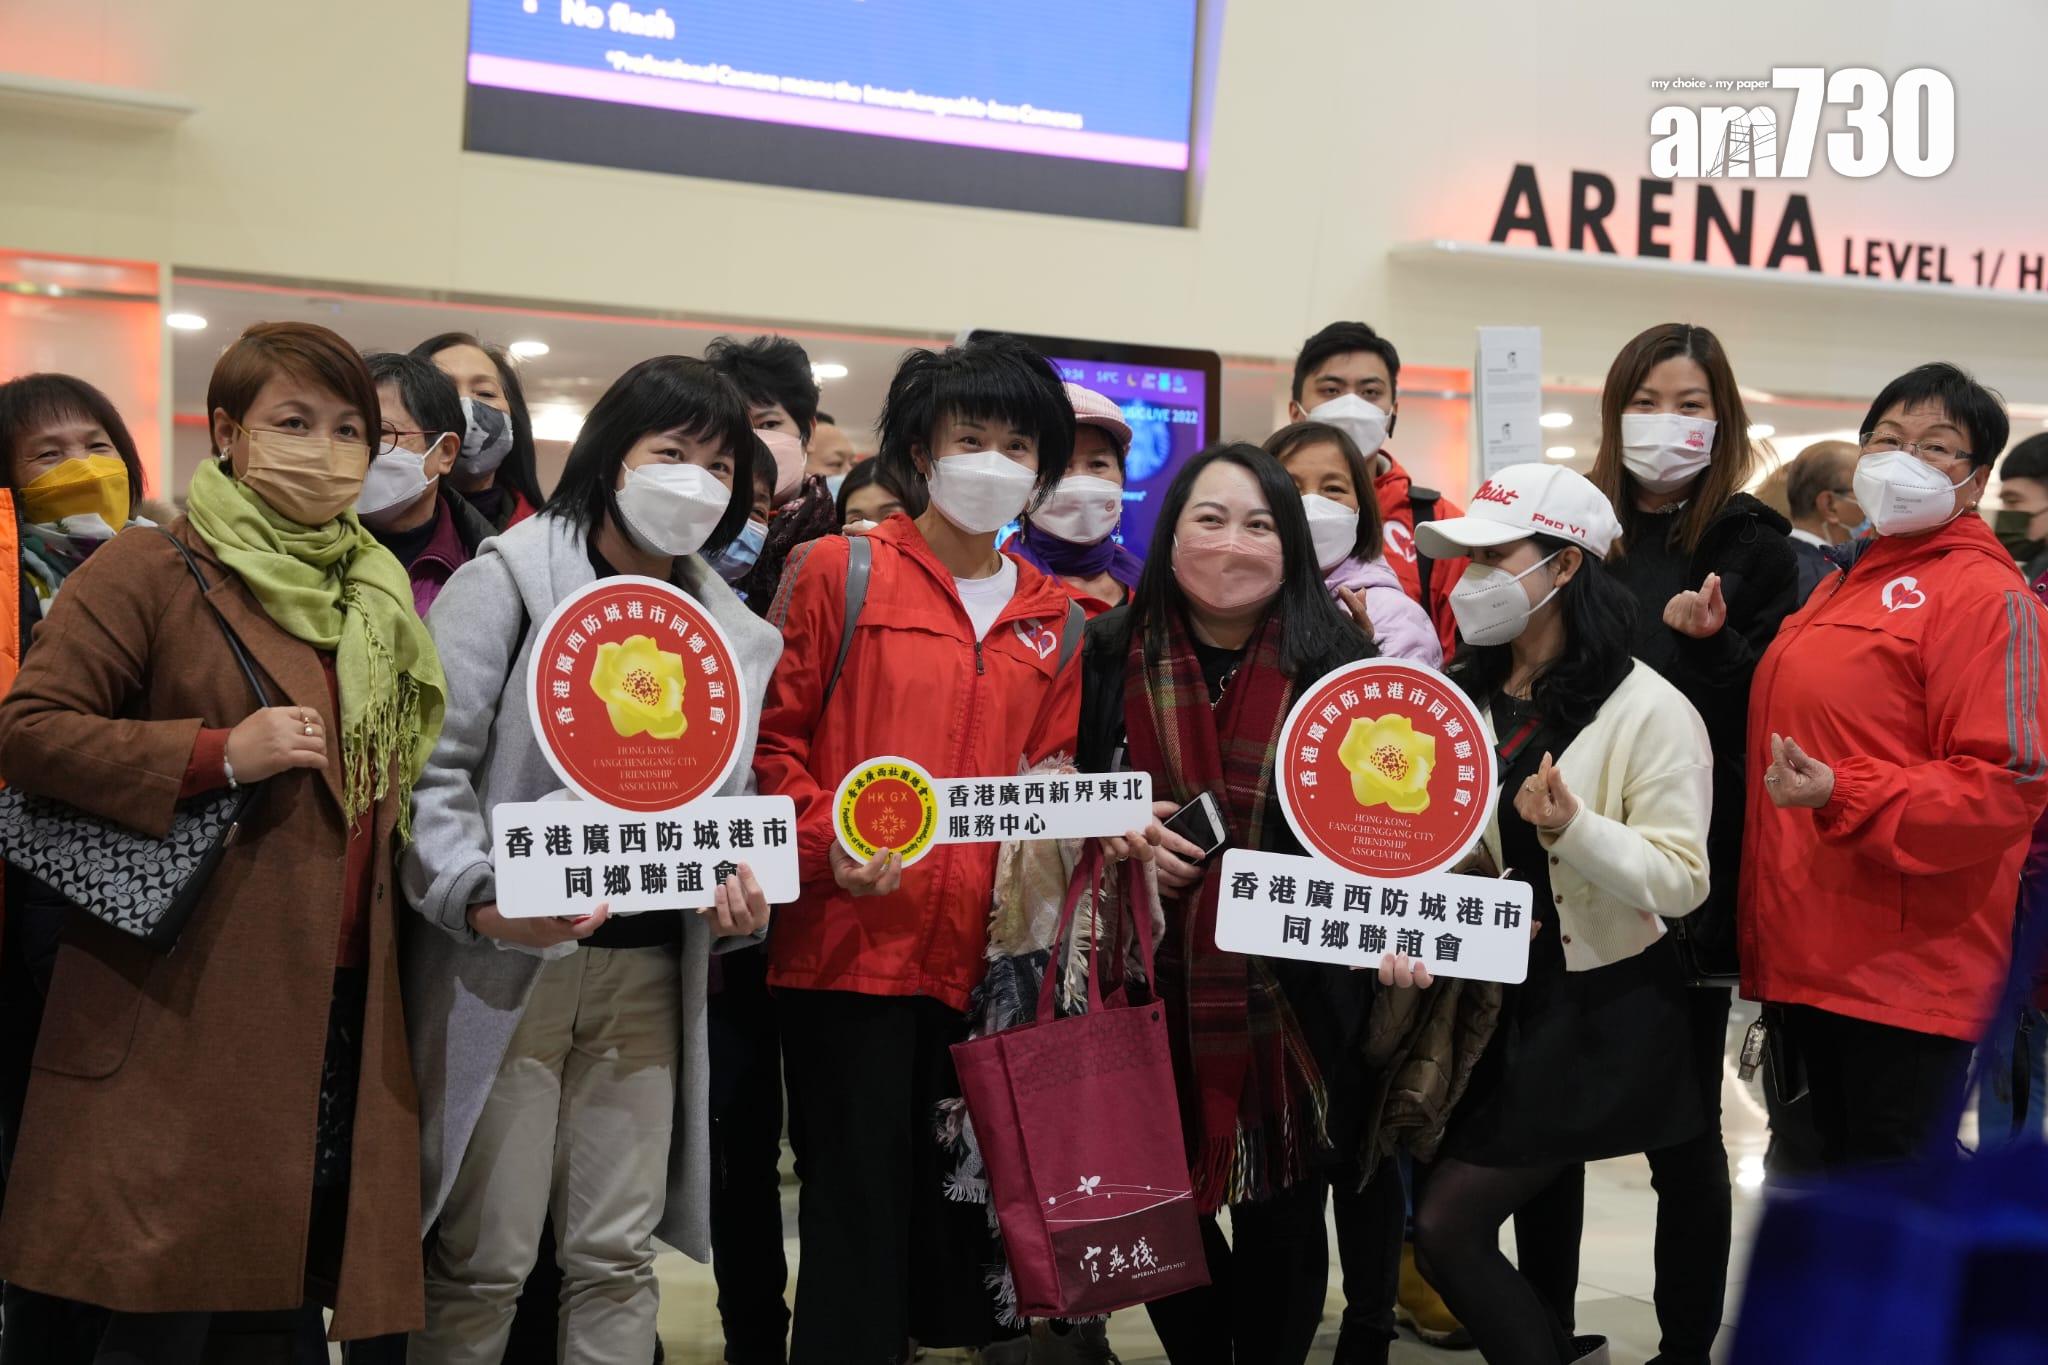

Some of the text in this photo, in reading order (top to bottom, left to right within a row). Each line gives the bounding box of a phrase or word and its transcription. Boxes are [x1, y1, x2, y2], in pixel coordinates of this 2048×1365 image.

[560, 0, 675, 40] No flash
[1489, 162, 1823, 273] ARENA
[1844, 236, 1955, 284] LEVEL
[2018, 253, 2048, 292] H
[1569, 524, 1587, 538] V1
[948, 778, 1144, 808] 香港廣西新界東北
[949, 813, 1046, 838] 服務中心
[1355, 813, 1412, 828] HONG KONG
[505, 817, 788, 859] 香港廣西防城港市
[1353, 835, 1407, 849] FRIENDSHIP
[1414, 831, 1436, 842] CITY
[1350, 846, 1412, 861] ASSOCIATION
[1230, 870, 1522, 929] 香港廣西防城港市
[1282, 914, 1463, 962] 同鄉聯誼會
